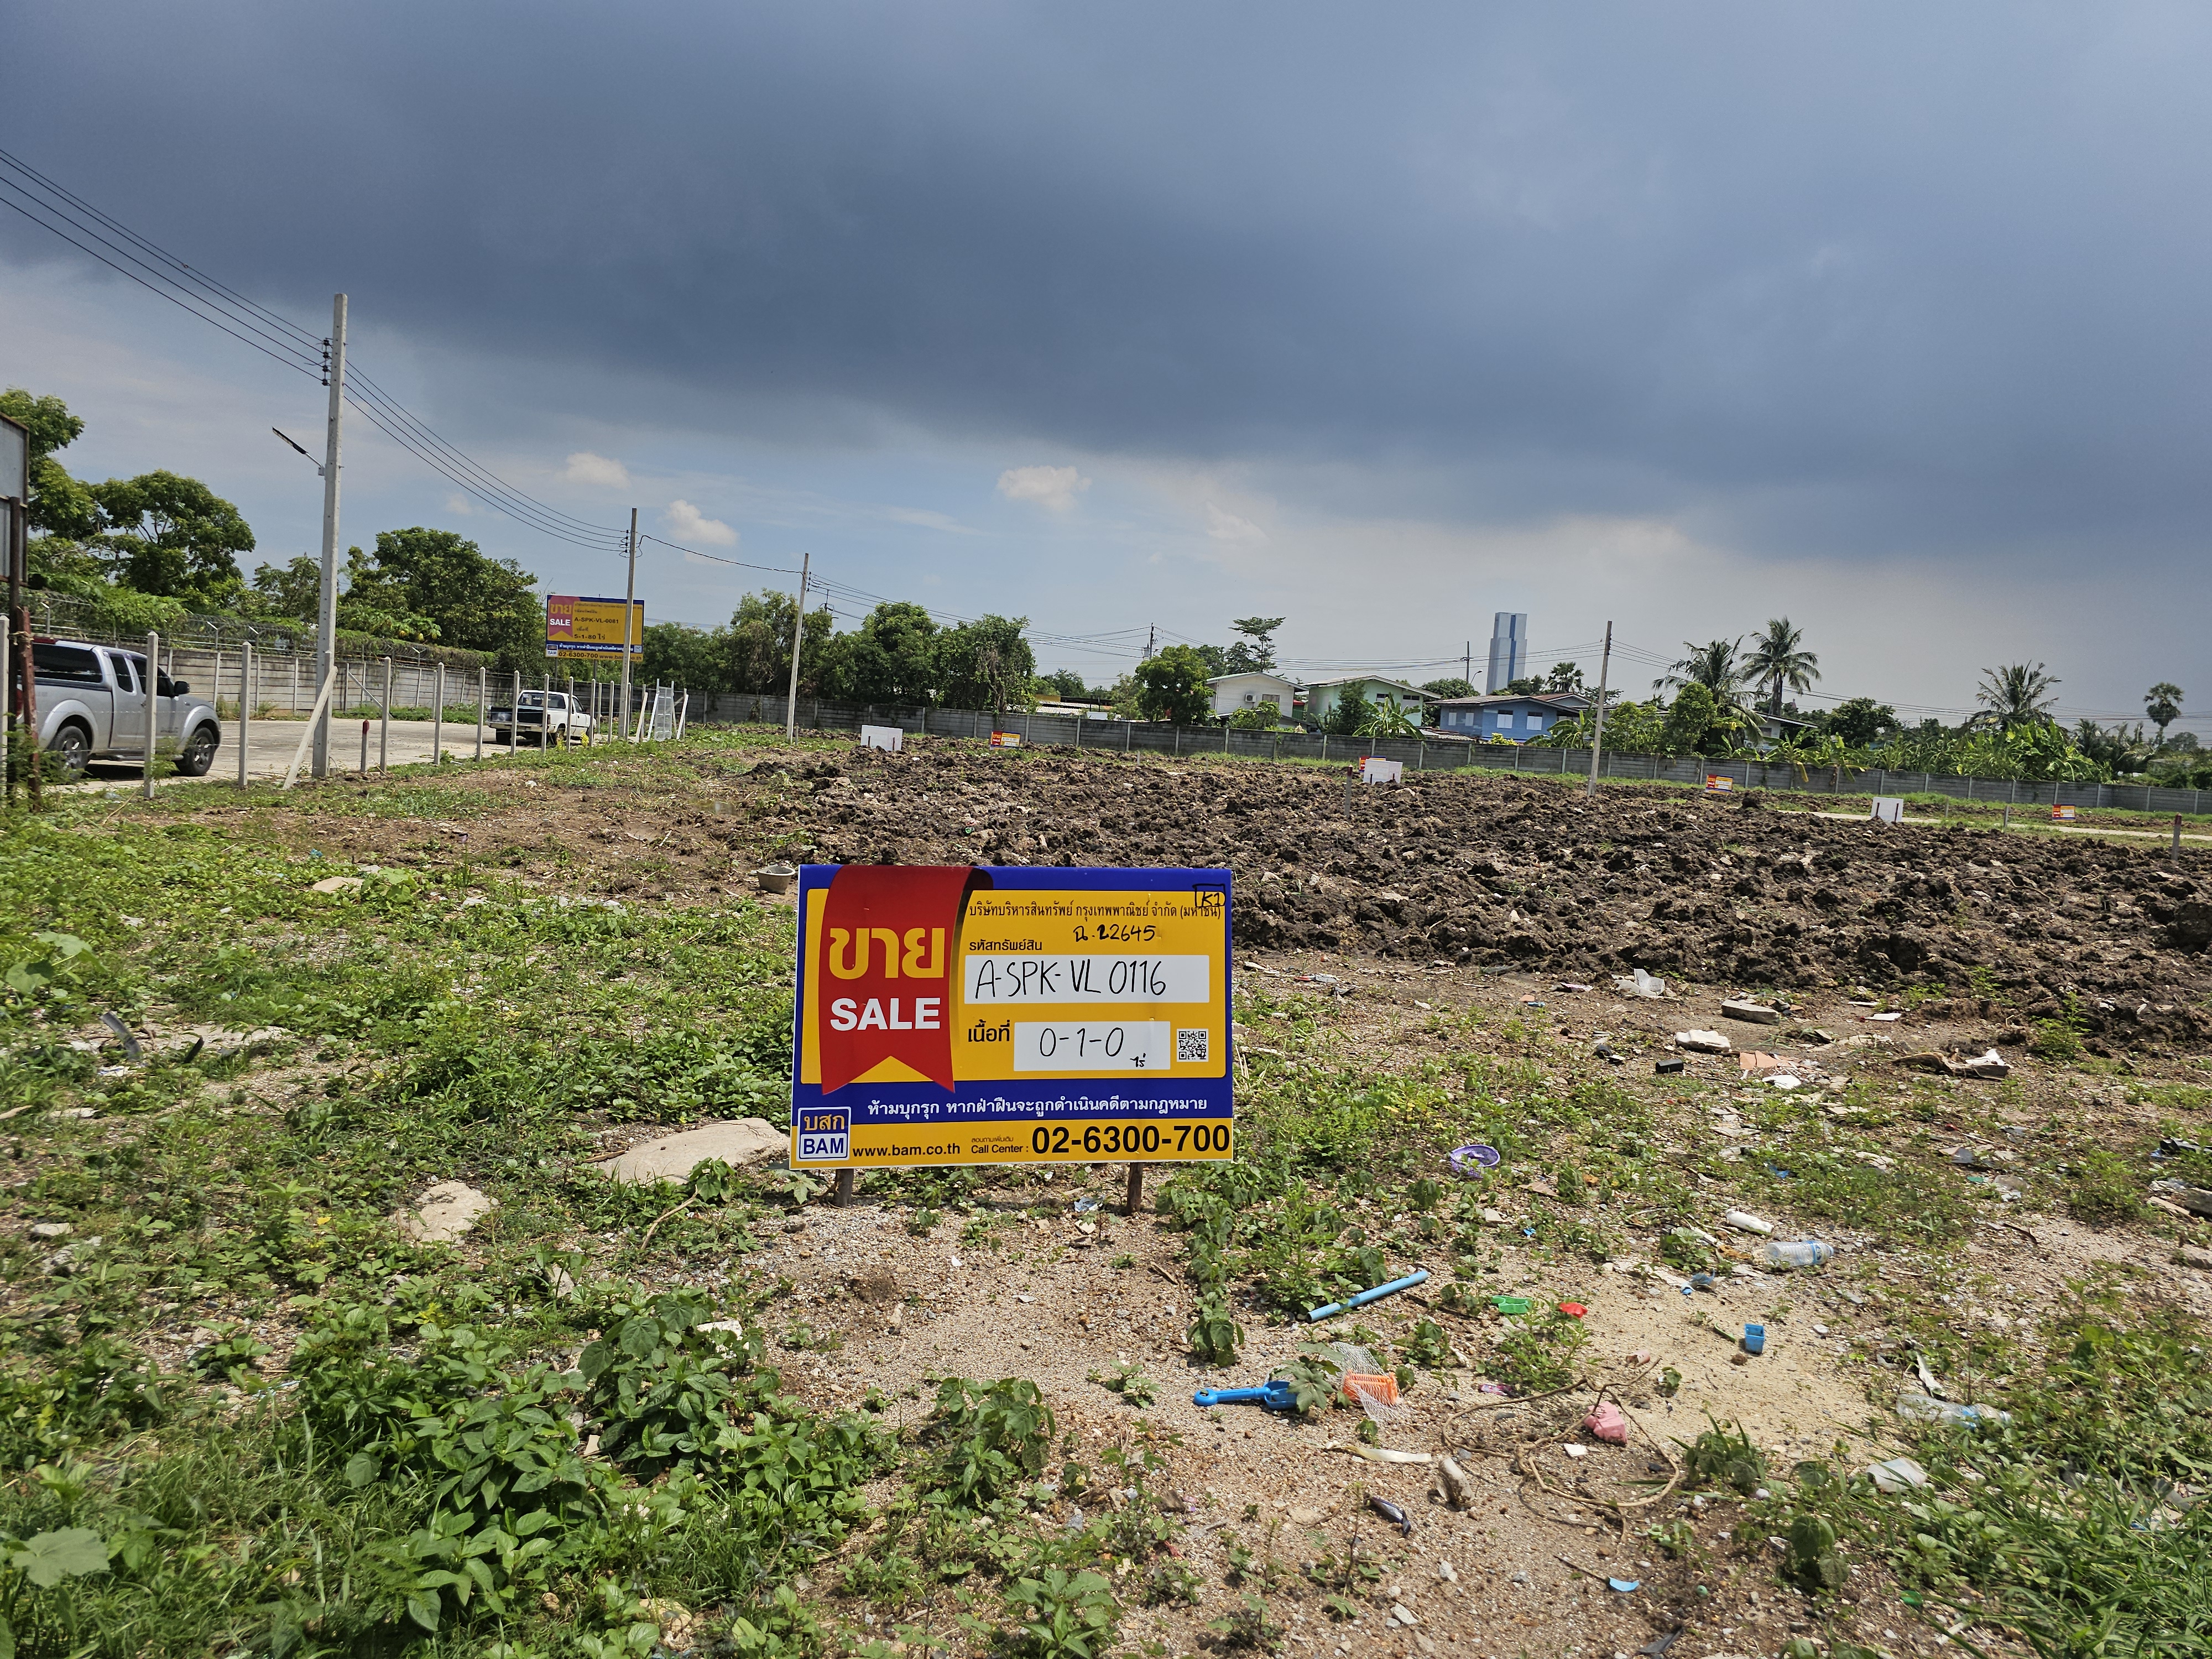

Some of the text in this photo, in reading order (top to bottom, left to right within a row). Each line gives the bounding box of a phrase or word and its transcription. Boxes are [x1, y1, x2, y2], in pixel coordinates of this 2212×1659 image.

[550, 604, 572, 615] ขาย
[969, 900, 1074, 916] บริษัทบริหารสินทรัพย์
[1076, 900, 1150, 922] กรุงเทพพาณิชย์
[1151, 901, 1177, 917] จำกัด
[829, 927, 945, 980] ขาย
[969, 938, 1042, 951] รหัสทรัพย์สิน
[830, 997, 941, 1031] SALE
[968, 1019, 1010, 1042] เนื้อที่
[868, 1094, 1207, 1120] ห้ามบุกรุก หากฝ่าฝืนจะถูกดำเนินคดีตามกฎหมาย
[804, 1113, 846, 1131] บสก
[802, 1137, 844, 1155] BAM
[971, 1144, 989, 1154] Call
[992, 1144, 1024, 1153] Center
[1032, 1124, 1230, 1154] 02-6300-700
[852, 1142, 961, 1157] www.bam.co.th
